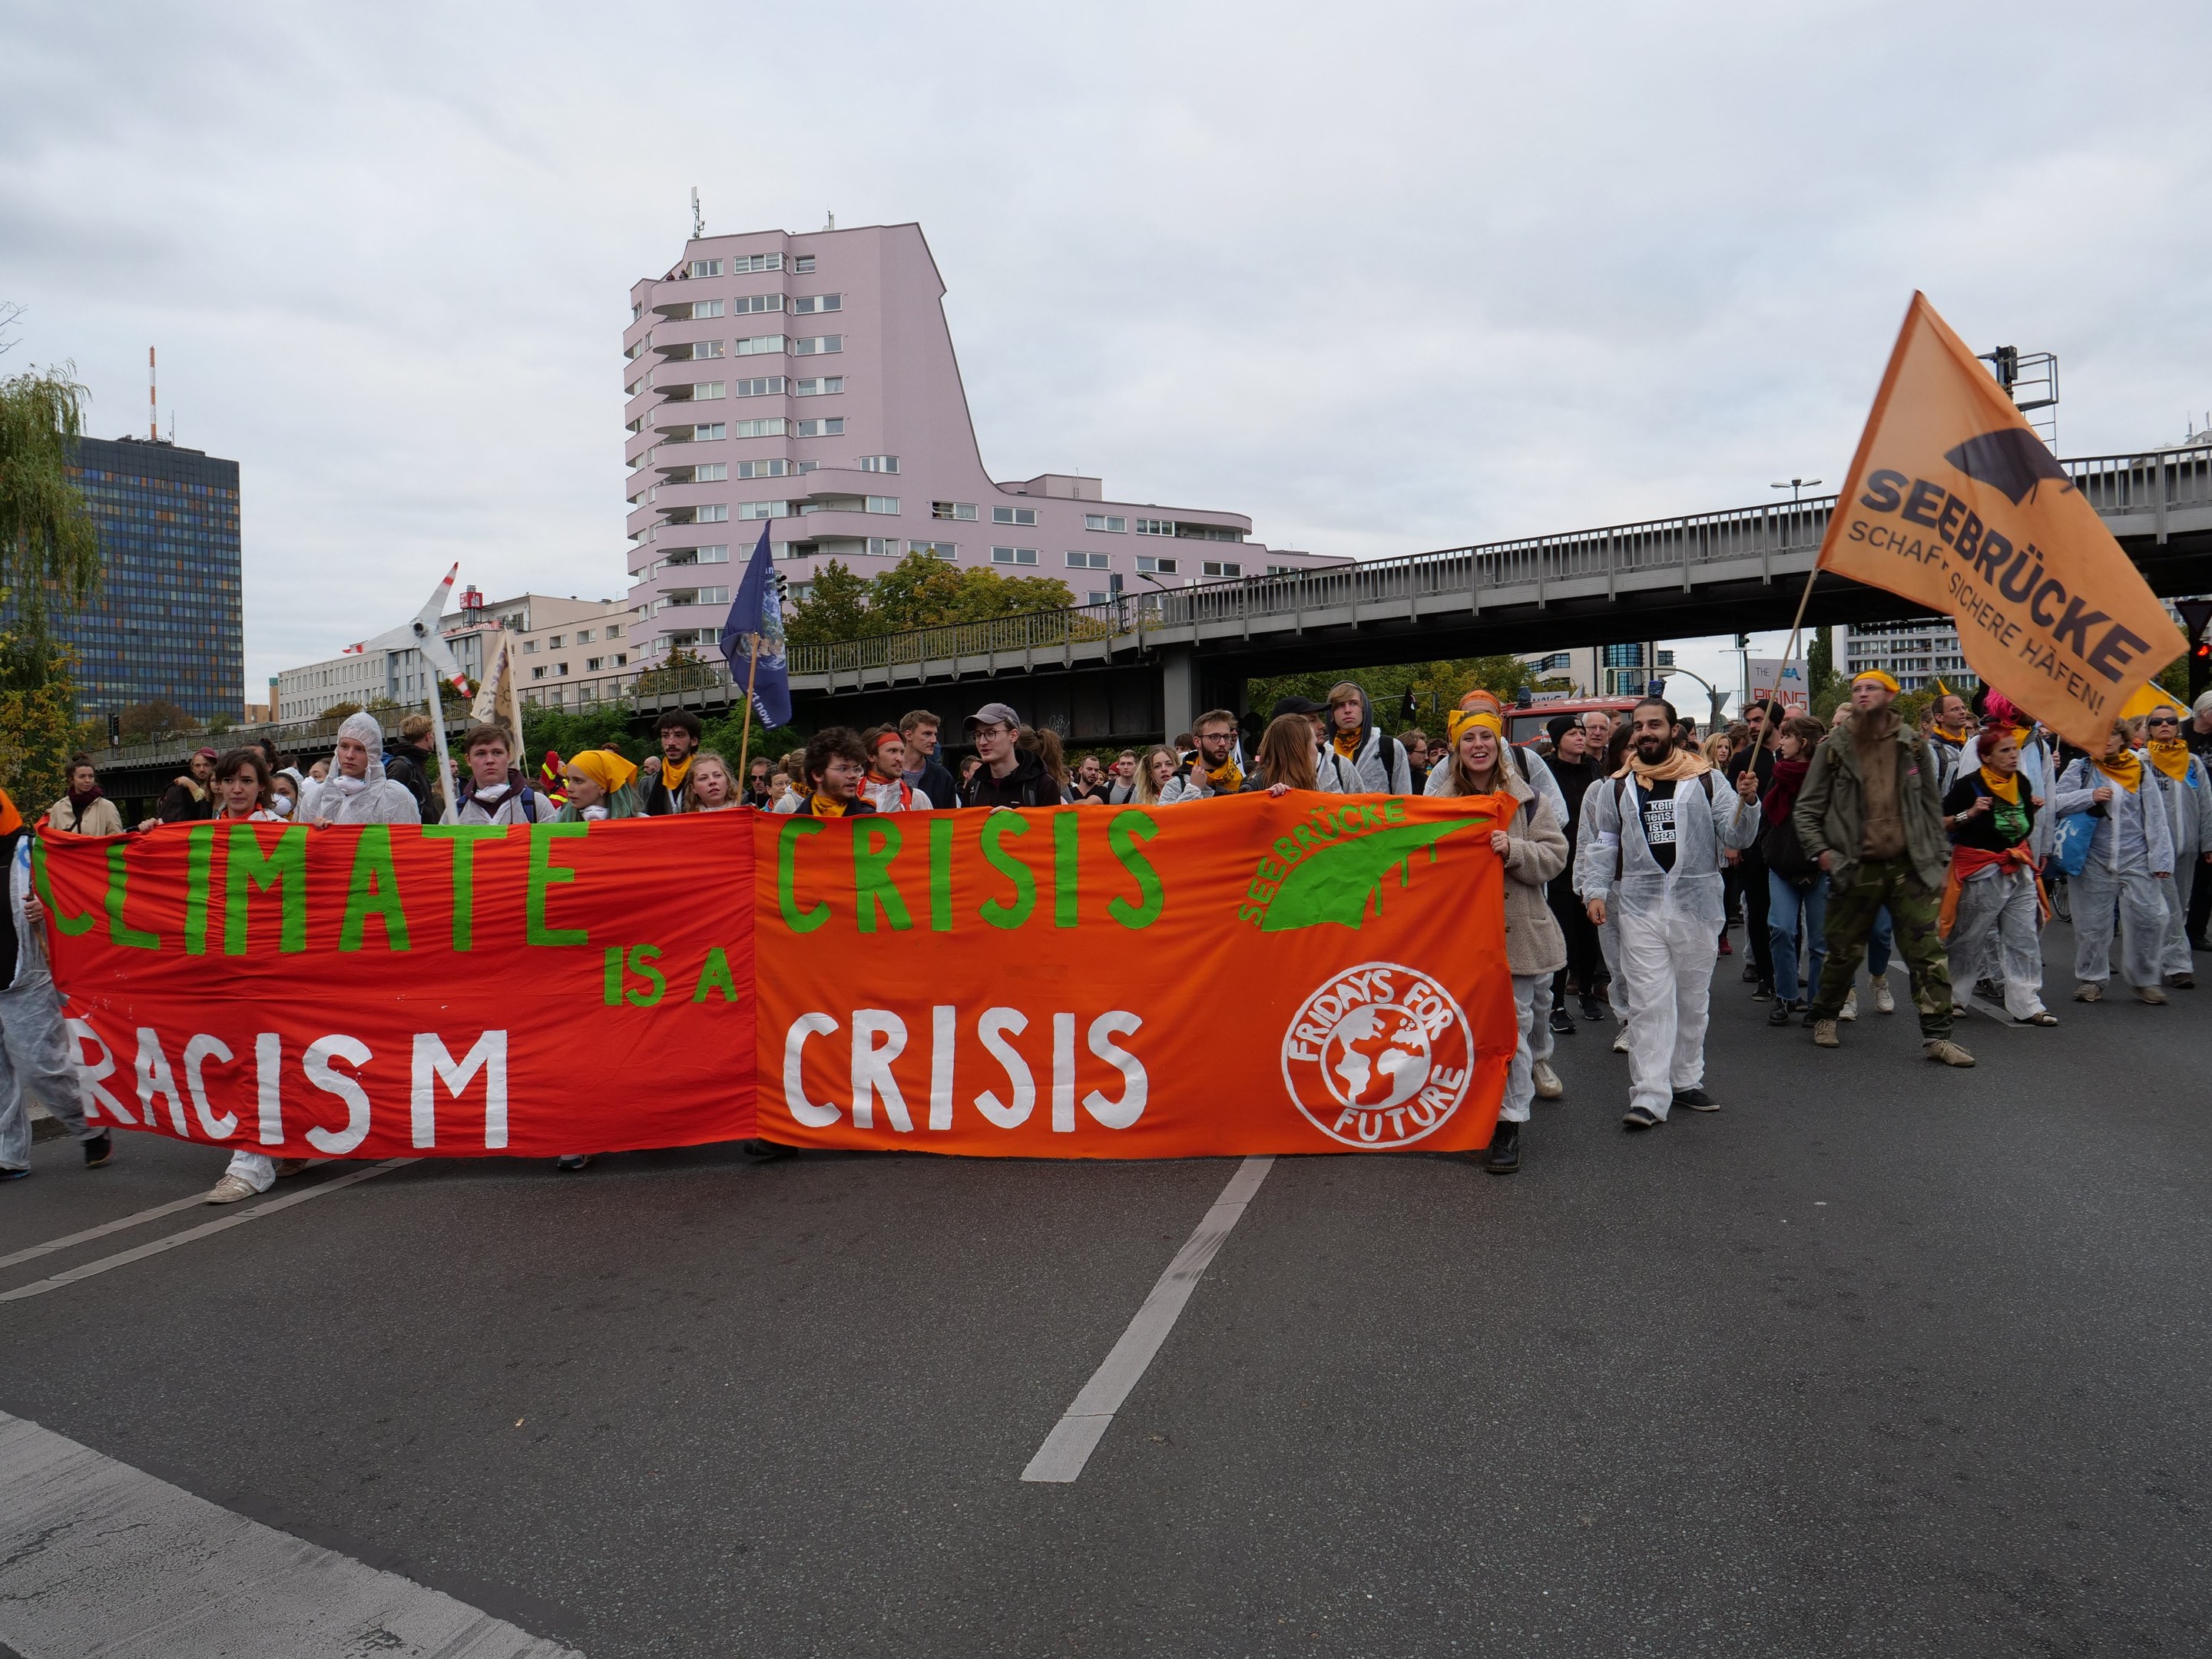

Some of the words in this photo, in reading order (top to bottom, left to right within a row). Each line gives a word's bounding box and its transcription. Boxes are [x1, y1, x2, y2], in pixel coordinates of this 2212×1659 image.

[1859, 469, 2151, 684] SEEBRÜCKE
[1755, 667, 1770, 677] THE
[1948, 571, 2022, 647] SICHERE
[2018, 637, 2105, 717] HÄFEN!
[31, 822, 589, 955] CLIMATE
[777, 810, 1164, 933] CRISIS
[1238, 799, 1406, 926] SEEBRÜCKE
[604, 944, 667, 1007] IS
[693, 947, 737, 1002] A
[1288, 969, 1394, 1061] FRIDAYS
[1403, 982, 1453, 1041] FOR
[68, 1017, 508, 1154] RACISM
[783, 1005, 1149, 1133] CRISIS
[1333, 1065, 1465, 1141] FUTURE
